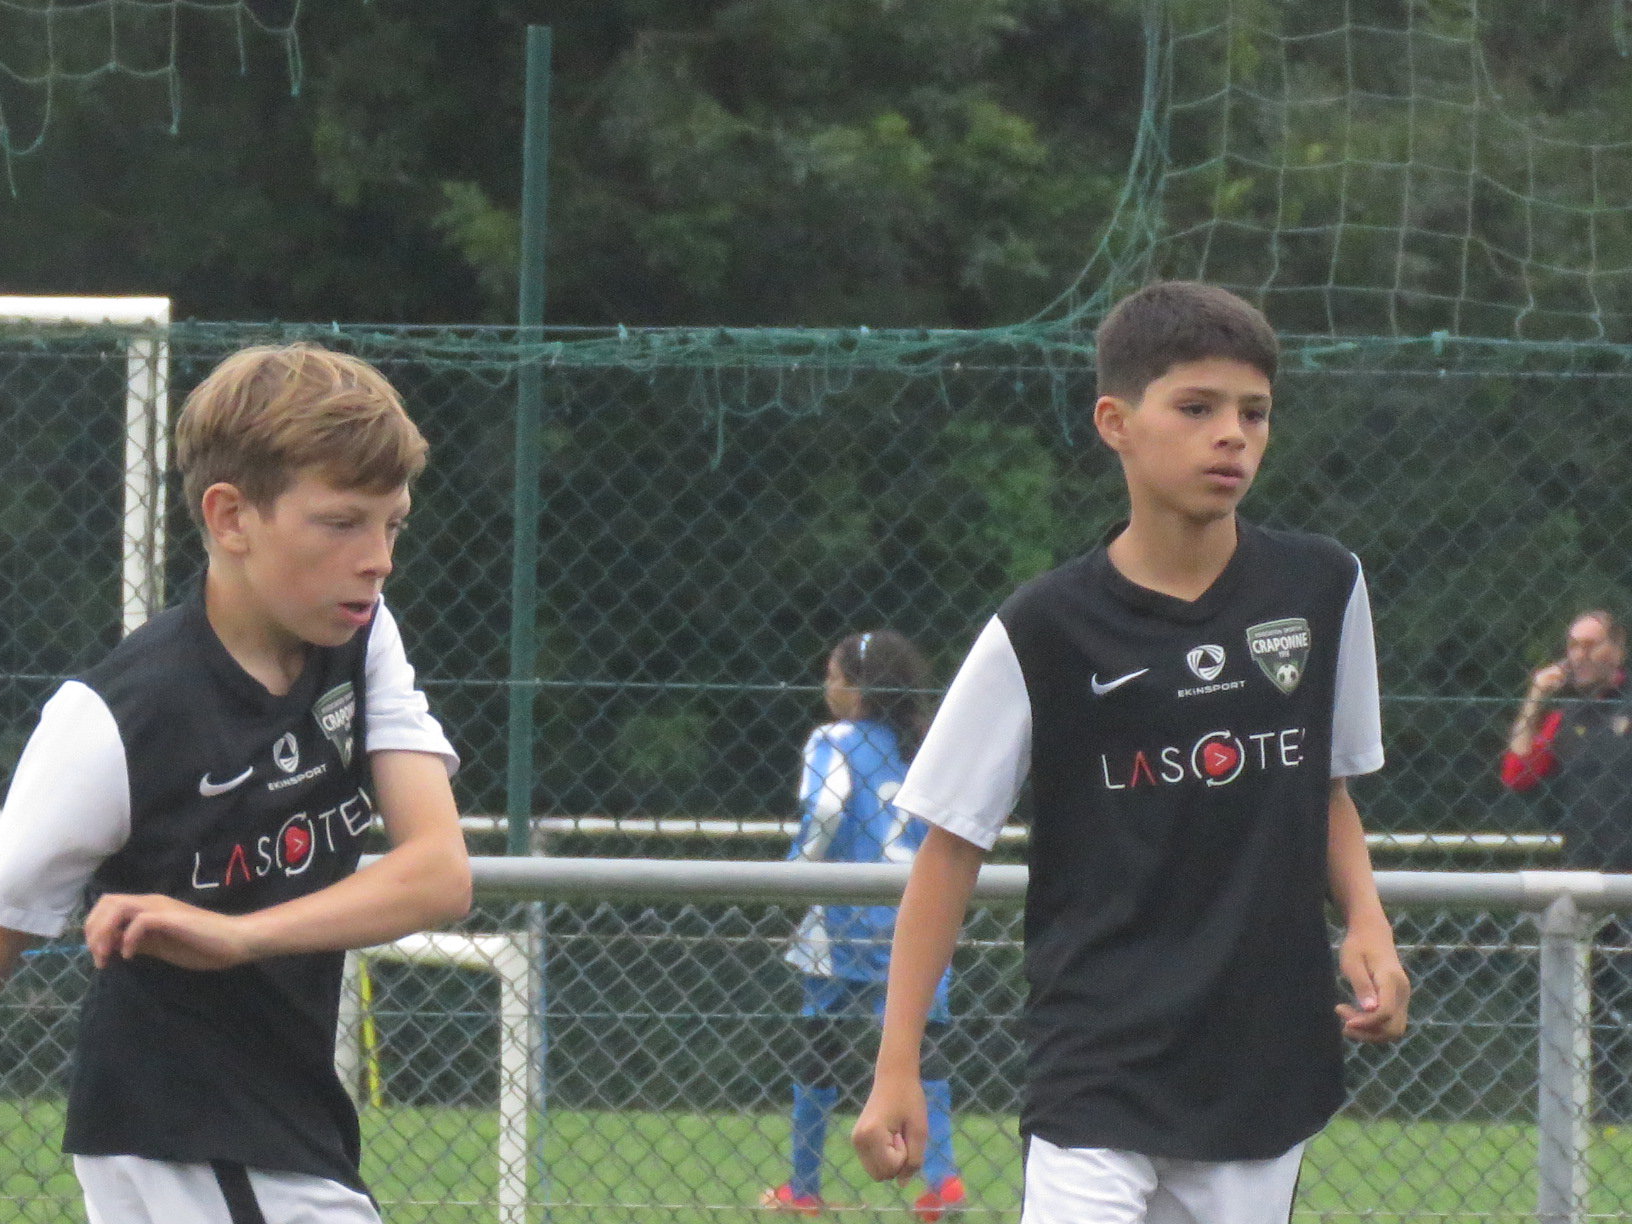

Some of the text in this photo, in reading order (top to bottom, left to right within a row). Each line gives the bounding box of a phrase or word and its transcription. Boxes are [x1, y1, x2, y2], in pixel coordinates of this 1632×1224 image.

[1252, 632, 1309, 654] CRAPONNE
[1177, 680, 1245, 698] EKINSPORT
[268, 763, 327, 791] EKINSPORT
